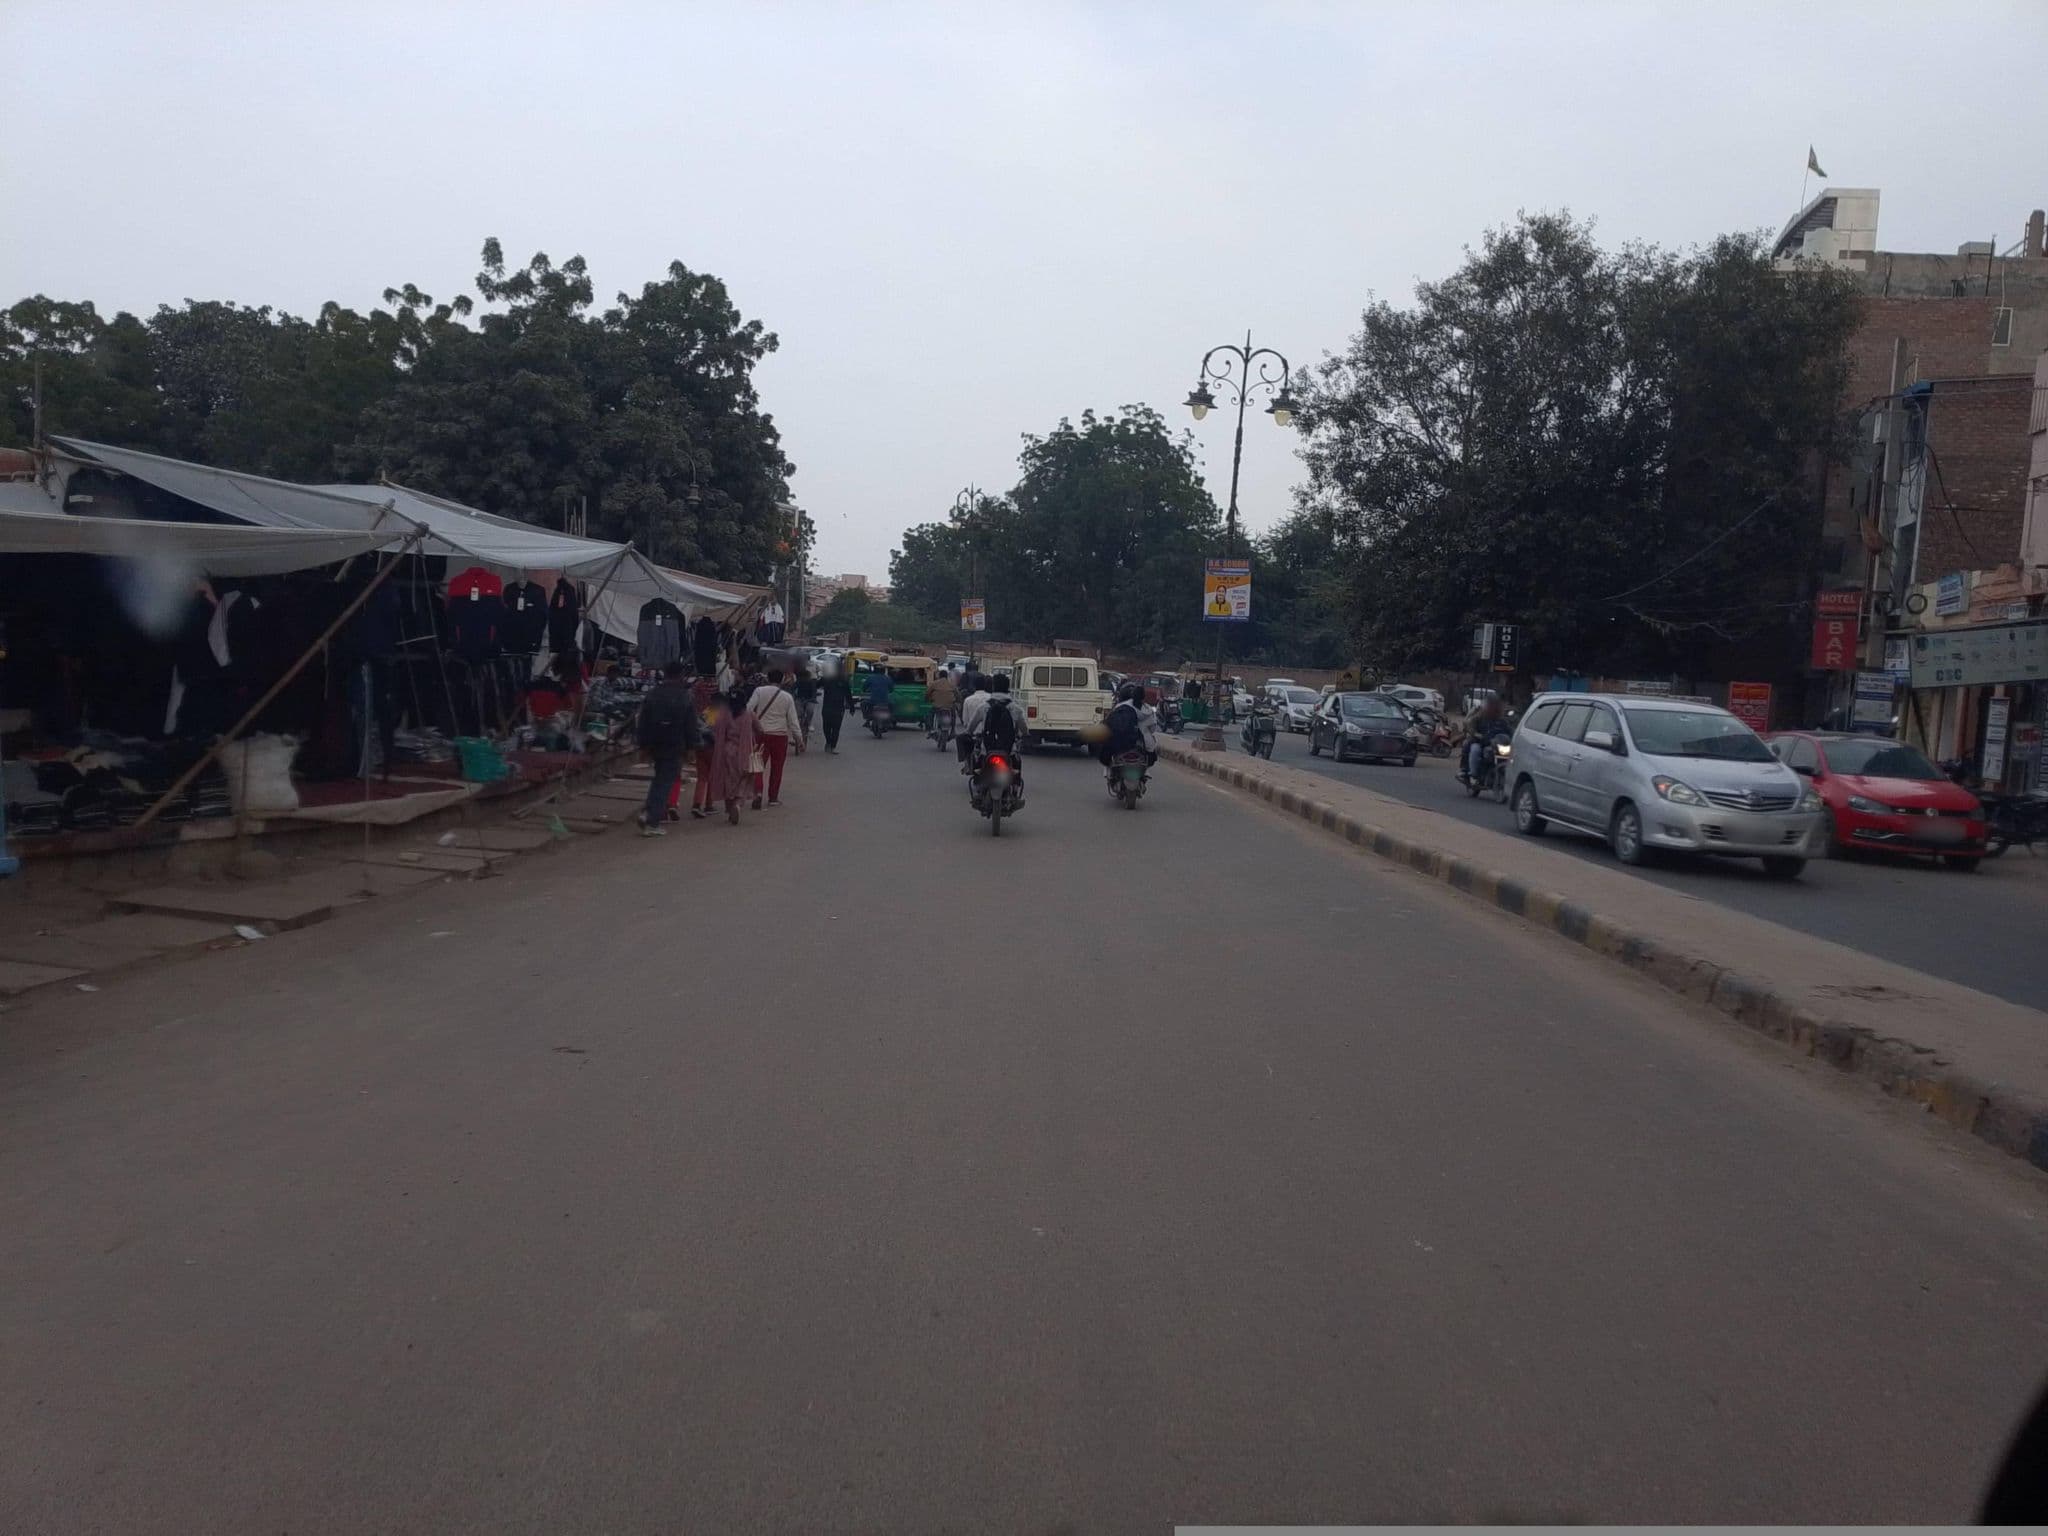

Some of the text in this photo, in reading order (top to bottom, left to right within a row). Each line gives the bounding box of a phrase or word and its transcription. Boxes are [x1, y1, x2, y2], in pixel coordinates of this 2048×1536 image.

[1821, 594, 1856, 604] HOTEL
[1501, 627, 1512, 665] HOTEL
[1825, 622, 1844, 665] BAR
